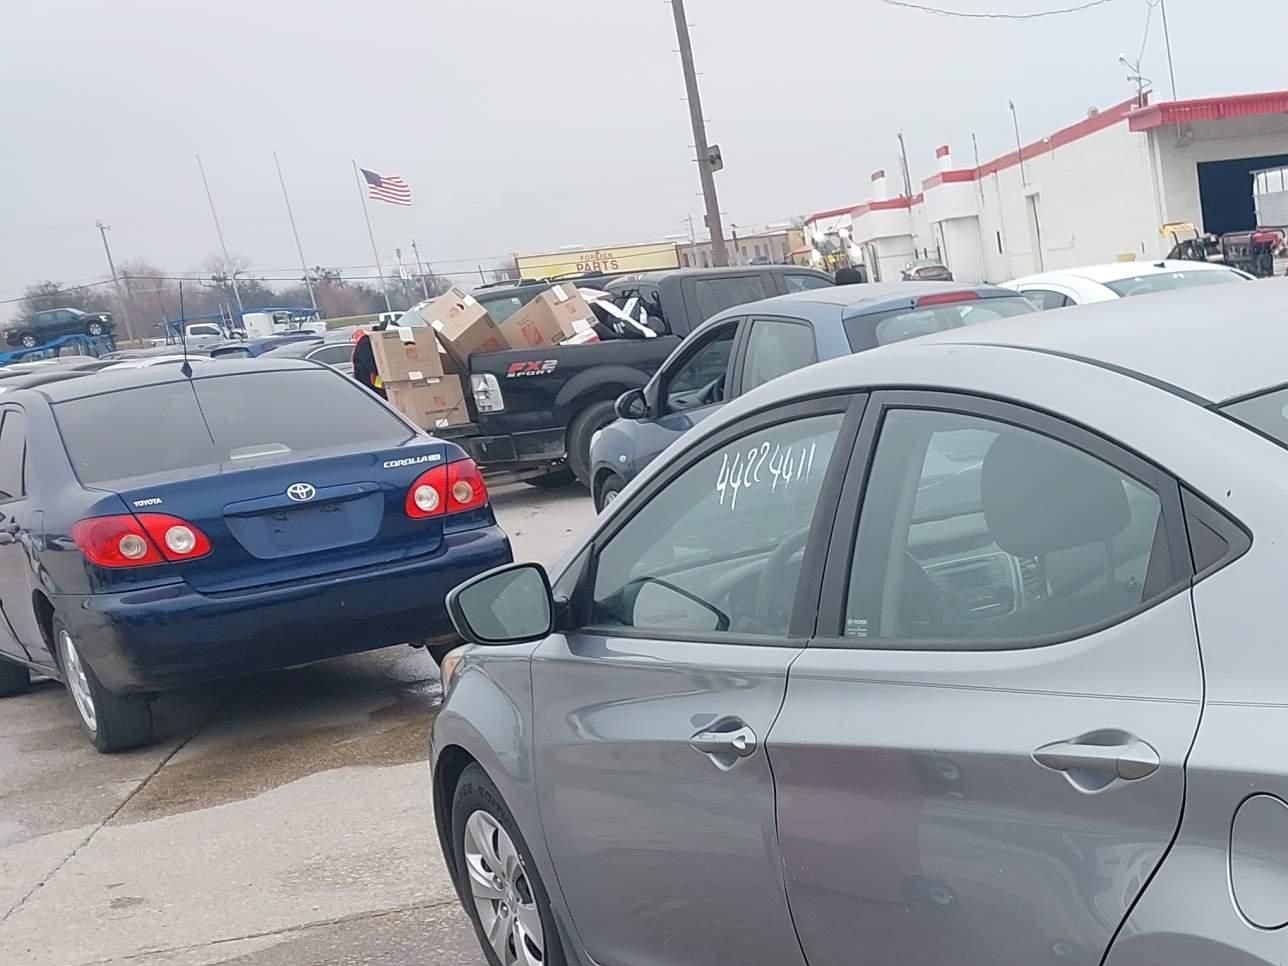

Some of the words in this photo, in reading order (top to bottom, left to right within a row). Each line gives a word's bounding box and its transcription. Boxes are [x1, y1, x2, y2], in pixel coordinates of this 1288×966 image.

[576, 260, 619, 271] PARTS
[508, 360, 558, 373] FX2
[506, 369, 555, 378] SPORT
[383, 456, 428, 468] COROLLA
[717, 441, 816, 510] 44224411
[133, 497, 163, 508] TOYOTA
